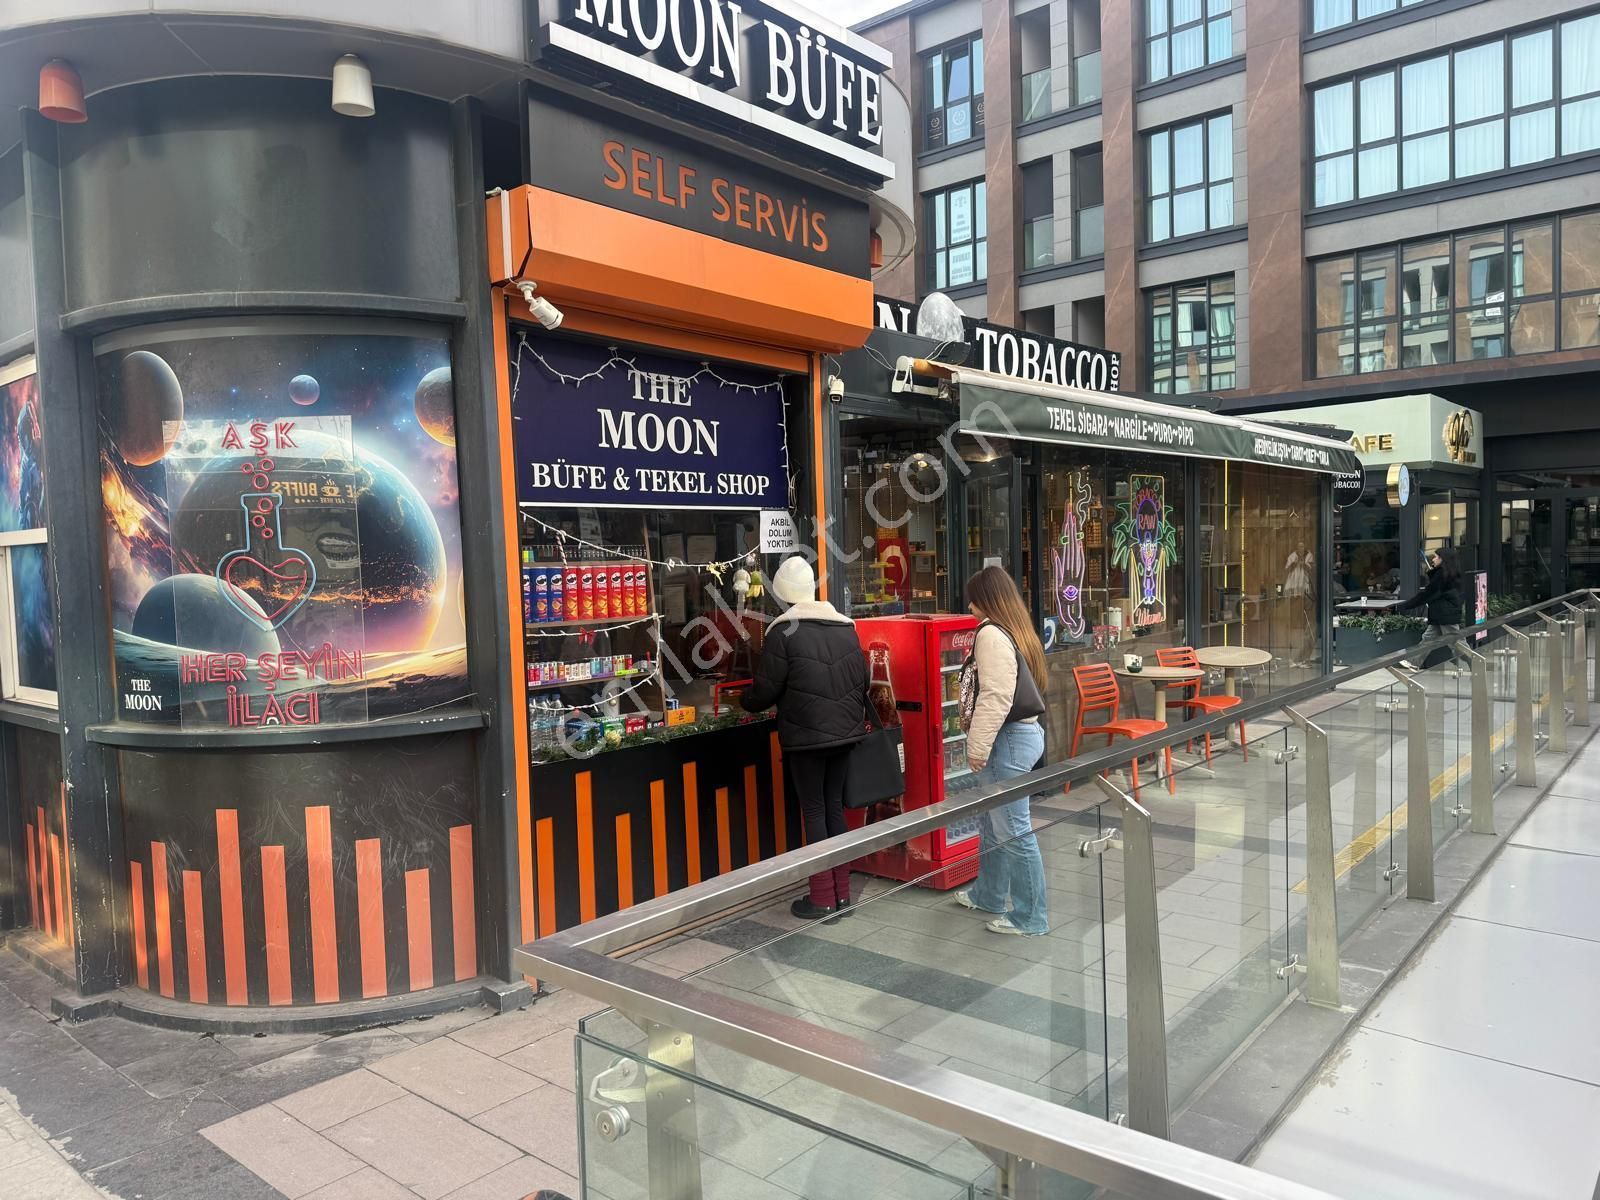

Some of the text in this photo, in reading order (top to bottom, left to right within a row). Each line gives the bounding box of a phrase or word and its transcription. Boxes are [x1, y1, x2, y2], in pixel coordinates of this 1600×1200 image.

[763, 19, 883, 145] BÜFE
[603, 141, 829, 252] SELF SERVİS
[975, 327, 1108, 391] TOBACCO
[1110, 353, 1120, 392] HOP
[627, 369, 692, 407] THE
[597, 408, 720, 457] MOON
[1046, 406, 1077, 433] TEKEL
[221, 422, 299, 457] AŞK
[1351, 434, 1393, 453] AFE
[531, 458, 770, 496] BÜFE & TEKEL SHOP
[768, 529, 792, 537] DOLUM
[770, 516, 791, 527] AKBİL
[767, 540, 794, 548] YOKTUR
[130, 679, 151, 692] THE
[180, 642, 365, 691] HER ŞEYİN
[125, 694, 162, 711] MOON
[226, 686, 320, 728] İLACI
